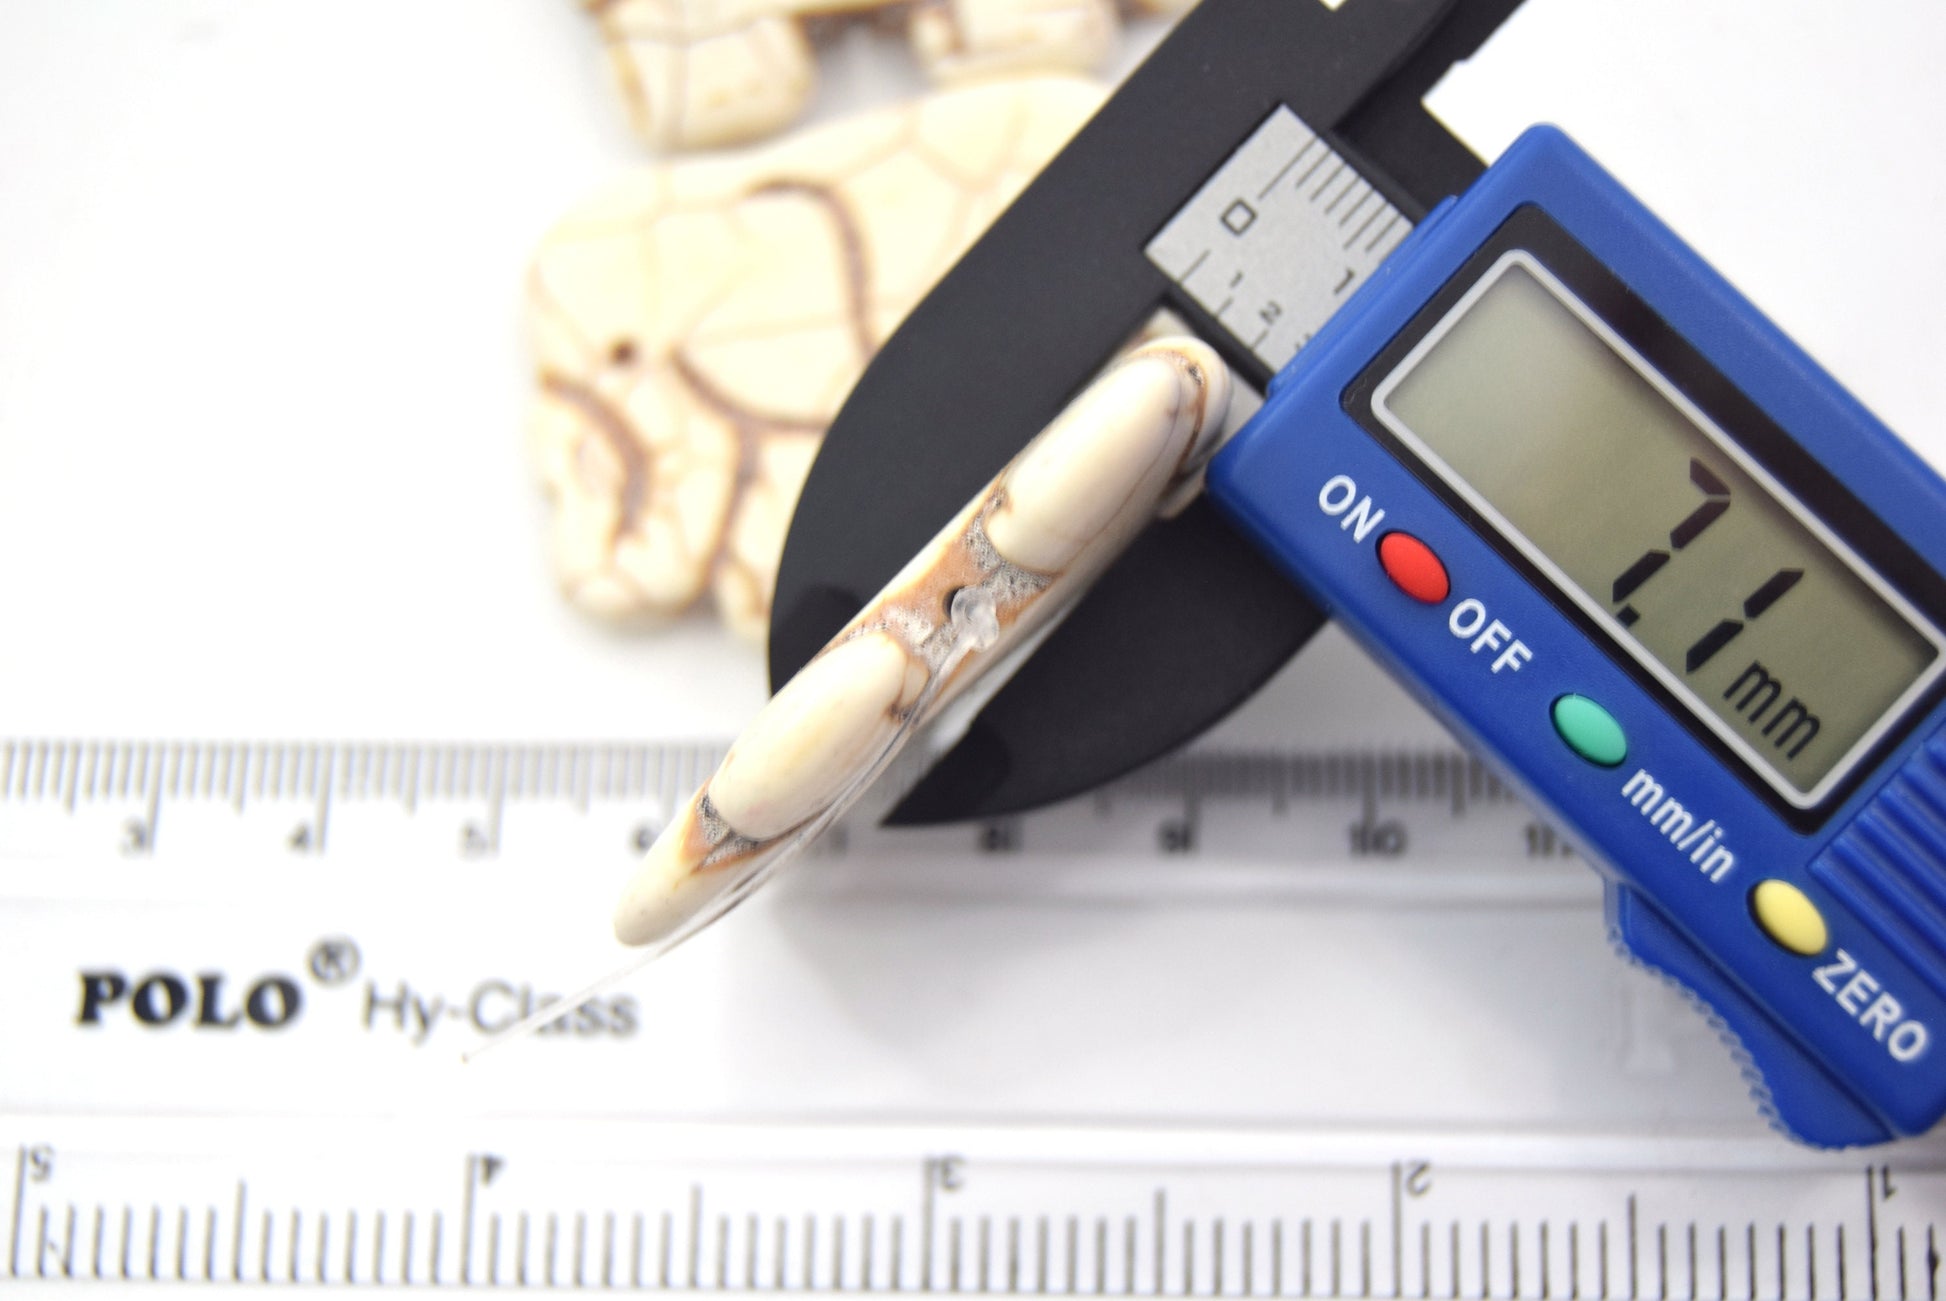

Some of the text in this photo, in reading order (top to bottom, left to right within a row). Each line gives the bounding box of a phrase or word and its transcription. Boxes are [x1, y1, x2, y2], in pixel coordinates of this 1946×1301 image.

[1259, 300, 1282, 325] 2
[1334, 270, 1355, 294] 1
[1318, 475, 1385, 543] ON
[1449, 598, 1533, 673] OFF
[1722, 660, 1822, 762] mm
[121, 820, 147, 854] 3
[288, 824, 311, 852] 4
[1621, 768, 1736, 882] mm/in
[75, 968, 303, 1029] POLO
[362, 980, 640, 1046] Hy-Class
[1812, 949, 1928, 1062] ZERO
[27, 1145, 53, 1181] 5
[480, 1154, 503, 1184] 4
[938, 1155, 966, 1192] 3
[1403, 1161, 1431, 1197] 2
